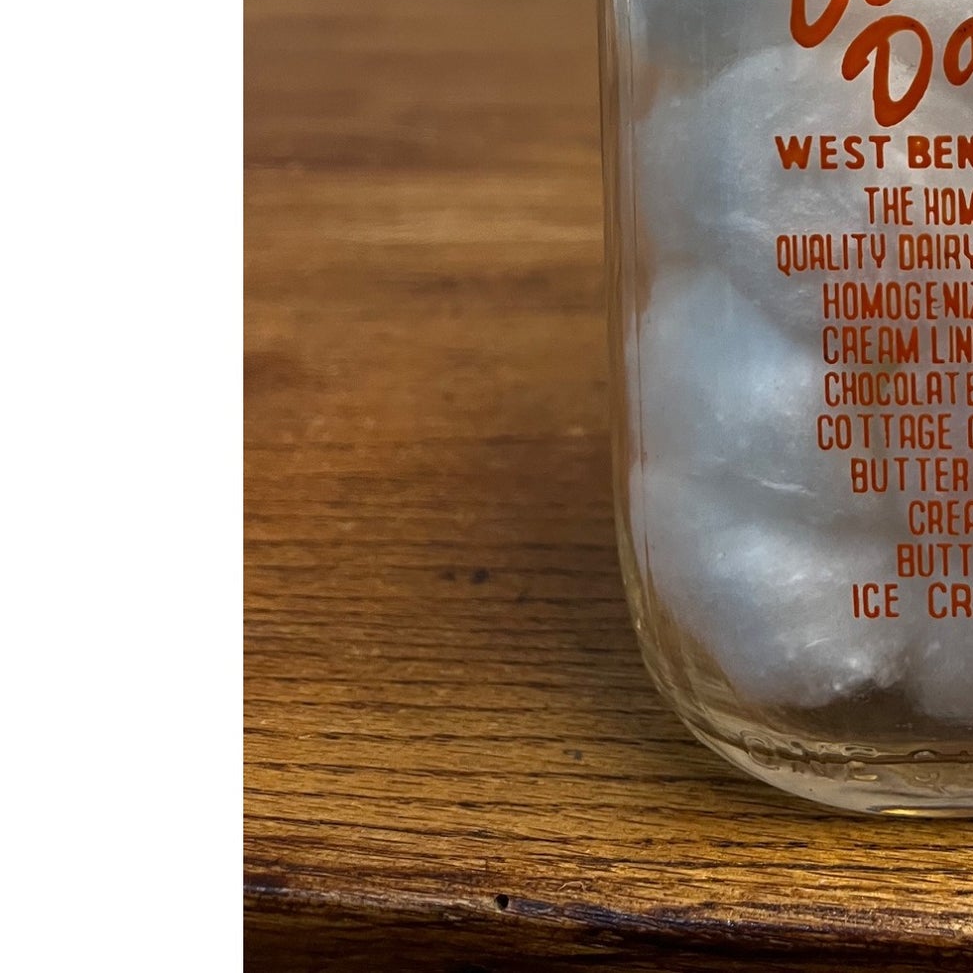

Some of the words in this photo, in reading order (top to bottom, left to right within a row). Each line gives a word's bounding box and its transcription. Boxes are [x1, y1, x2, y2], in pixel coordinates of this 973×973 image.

[775, 135, 891, 169] WEST
[864, 186, 913, 225] THE
[776, 233, 886, 276] QUALITY
[823, 325, 920, 364] CREAM
[817, 413, 953, 451] COTTAGE
[852, 582, 900, 619] ICE
